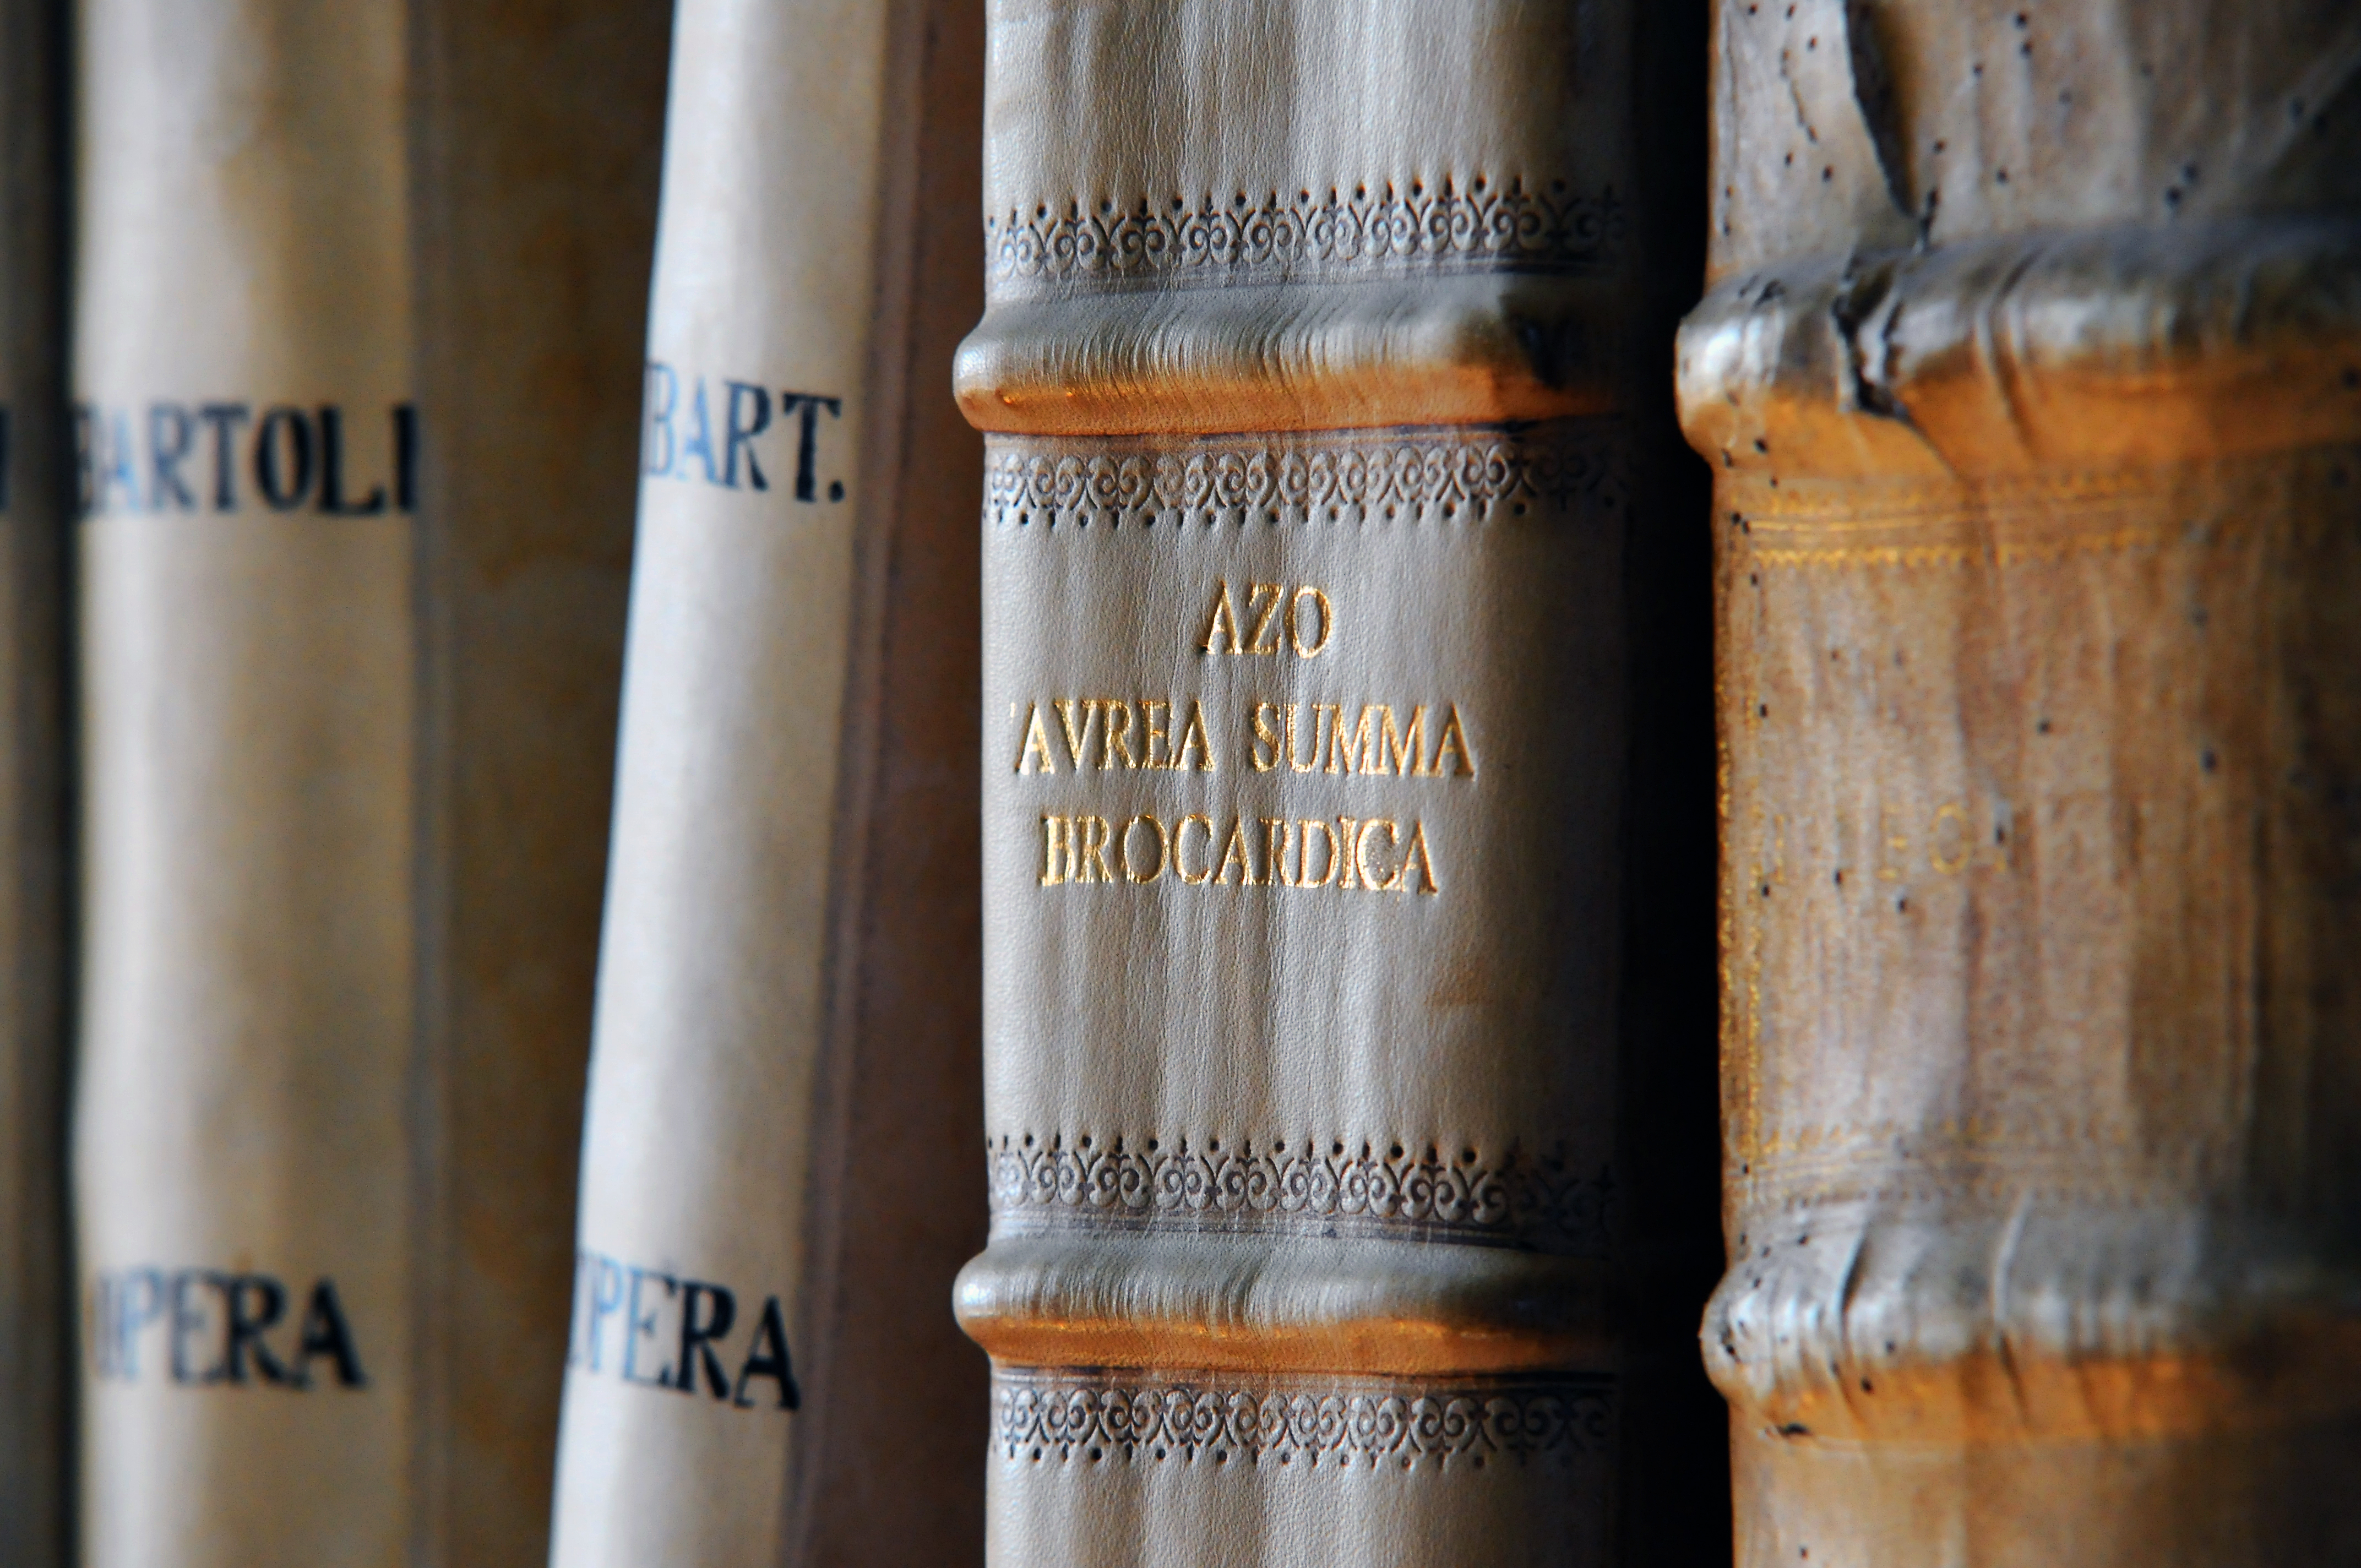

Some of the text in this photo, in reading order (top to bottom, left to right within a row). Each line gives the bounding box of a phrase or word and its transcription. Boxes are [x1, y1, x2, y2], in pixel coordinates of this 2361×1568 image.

[644, 360, 846, 503] BART.
[1199, 580, 1334, 660] AZO
[1014, 698, 1478, 780] AVREA SUMMA
[1038, 812, 1439, 894] BROCARDICA
[574, 1252, 803, 1411] PERA
